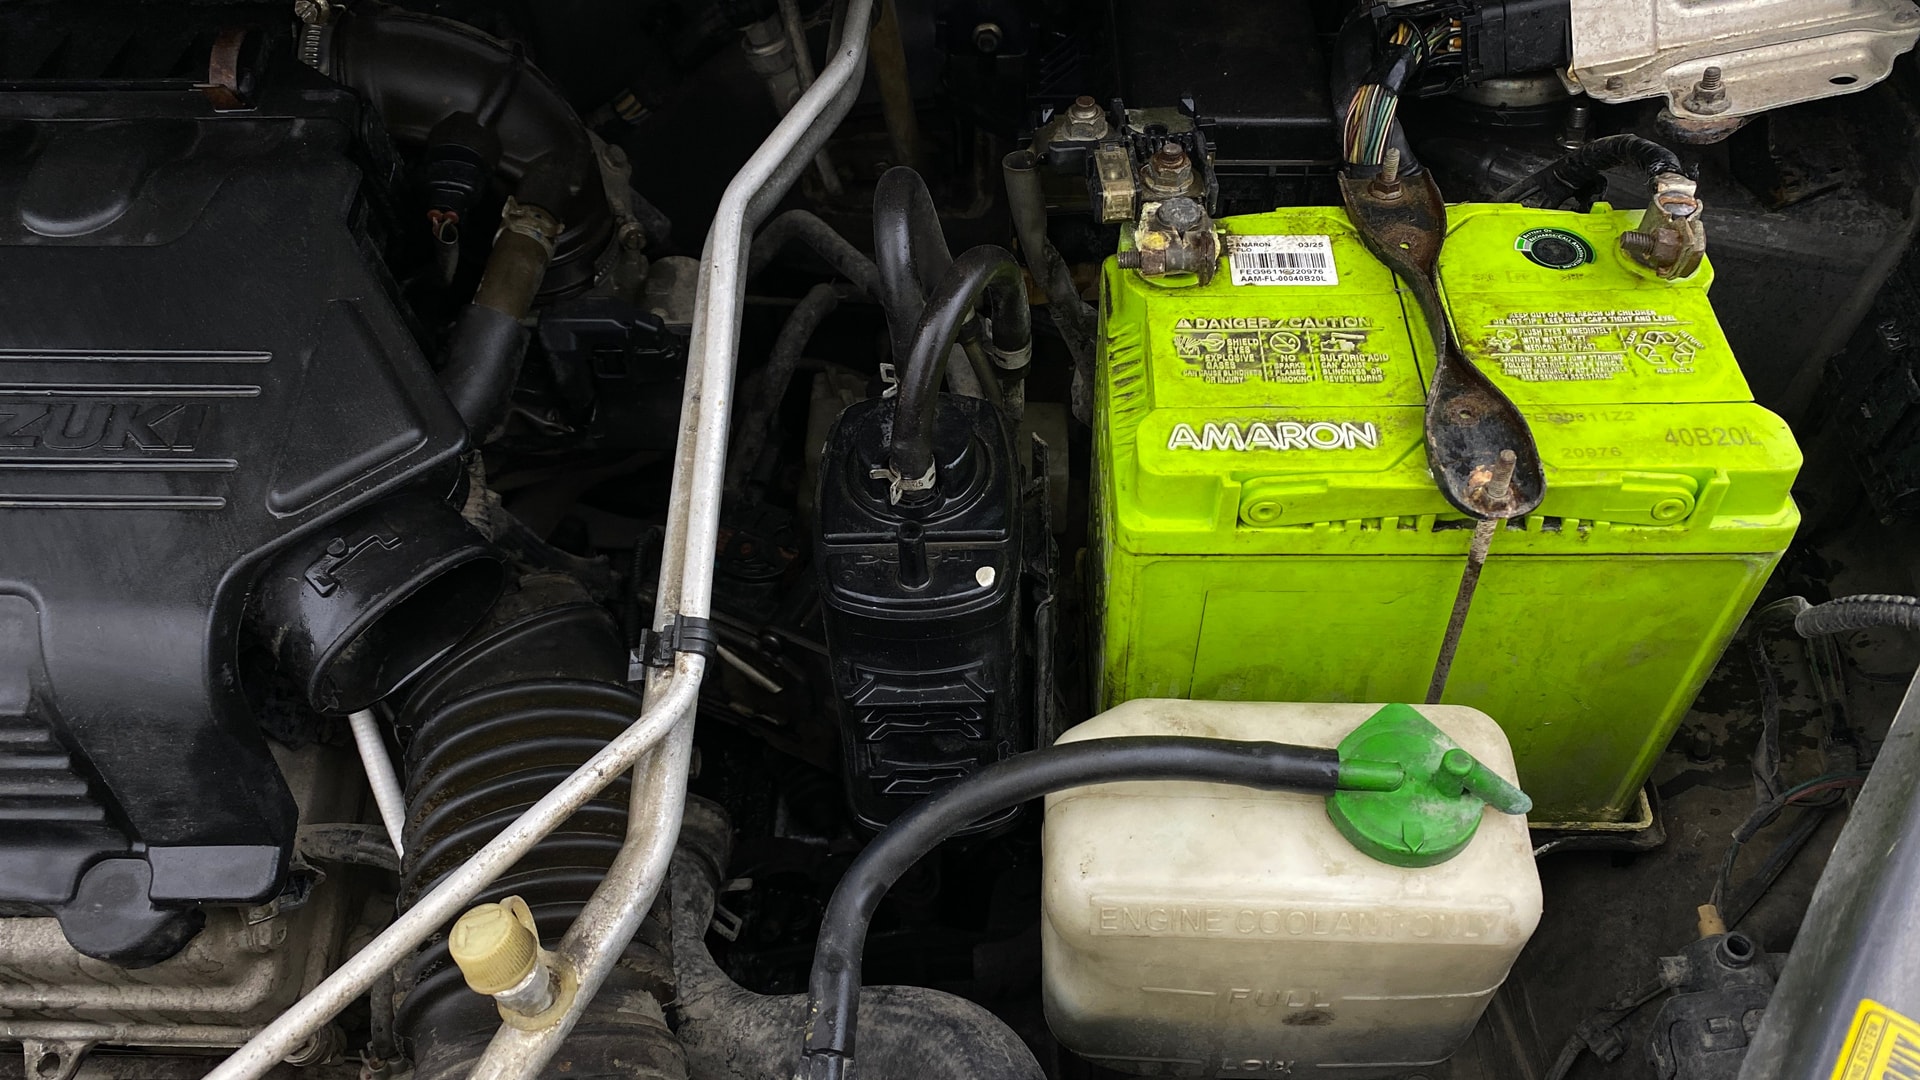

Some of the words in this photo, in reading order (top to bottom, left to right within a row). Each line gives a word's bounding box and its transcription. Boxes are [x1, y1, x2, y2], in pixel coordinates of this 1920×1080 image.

[1195, 318, 1270, 329] DANGER
[1288, 316, 1373, 328] CAUTION
[1226, 338, 1259, 346] SHIELD
[1227, 346, 1251, 354] EYES
[1204, 354, 1255, 362] EXPLOSIVE
[1280, 354, 1296, 362] NO
[1320, 354, 1366, 362] SULFURIC
[1367, 353, 1390, 362] ACID
[1206, 362, 1236, 370] GASES
[1168, 422, 1378, 451] AMARON
[1664, 426, 1763, 447] 40B20L
[1562, 446, 1623, 458] 20976
[1100, 906, 1222, 933] ENGINE
[1234, 909, 1401, 937] COOLANT
[1227, 988, 1331, 1008] FULL
